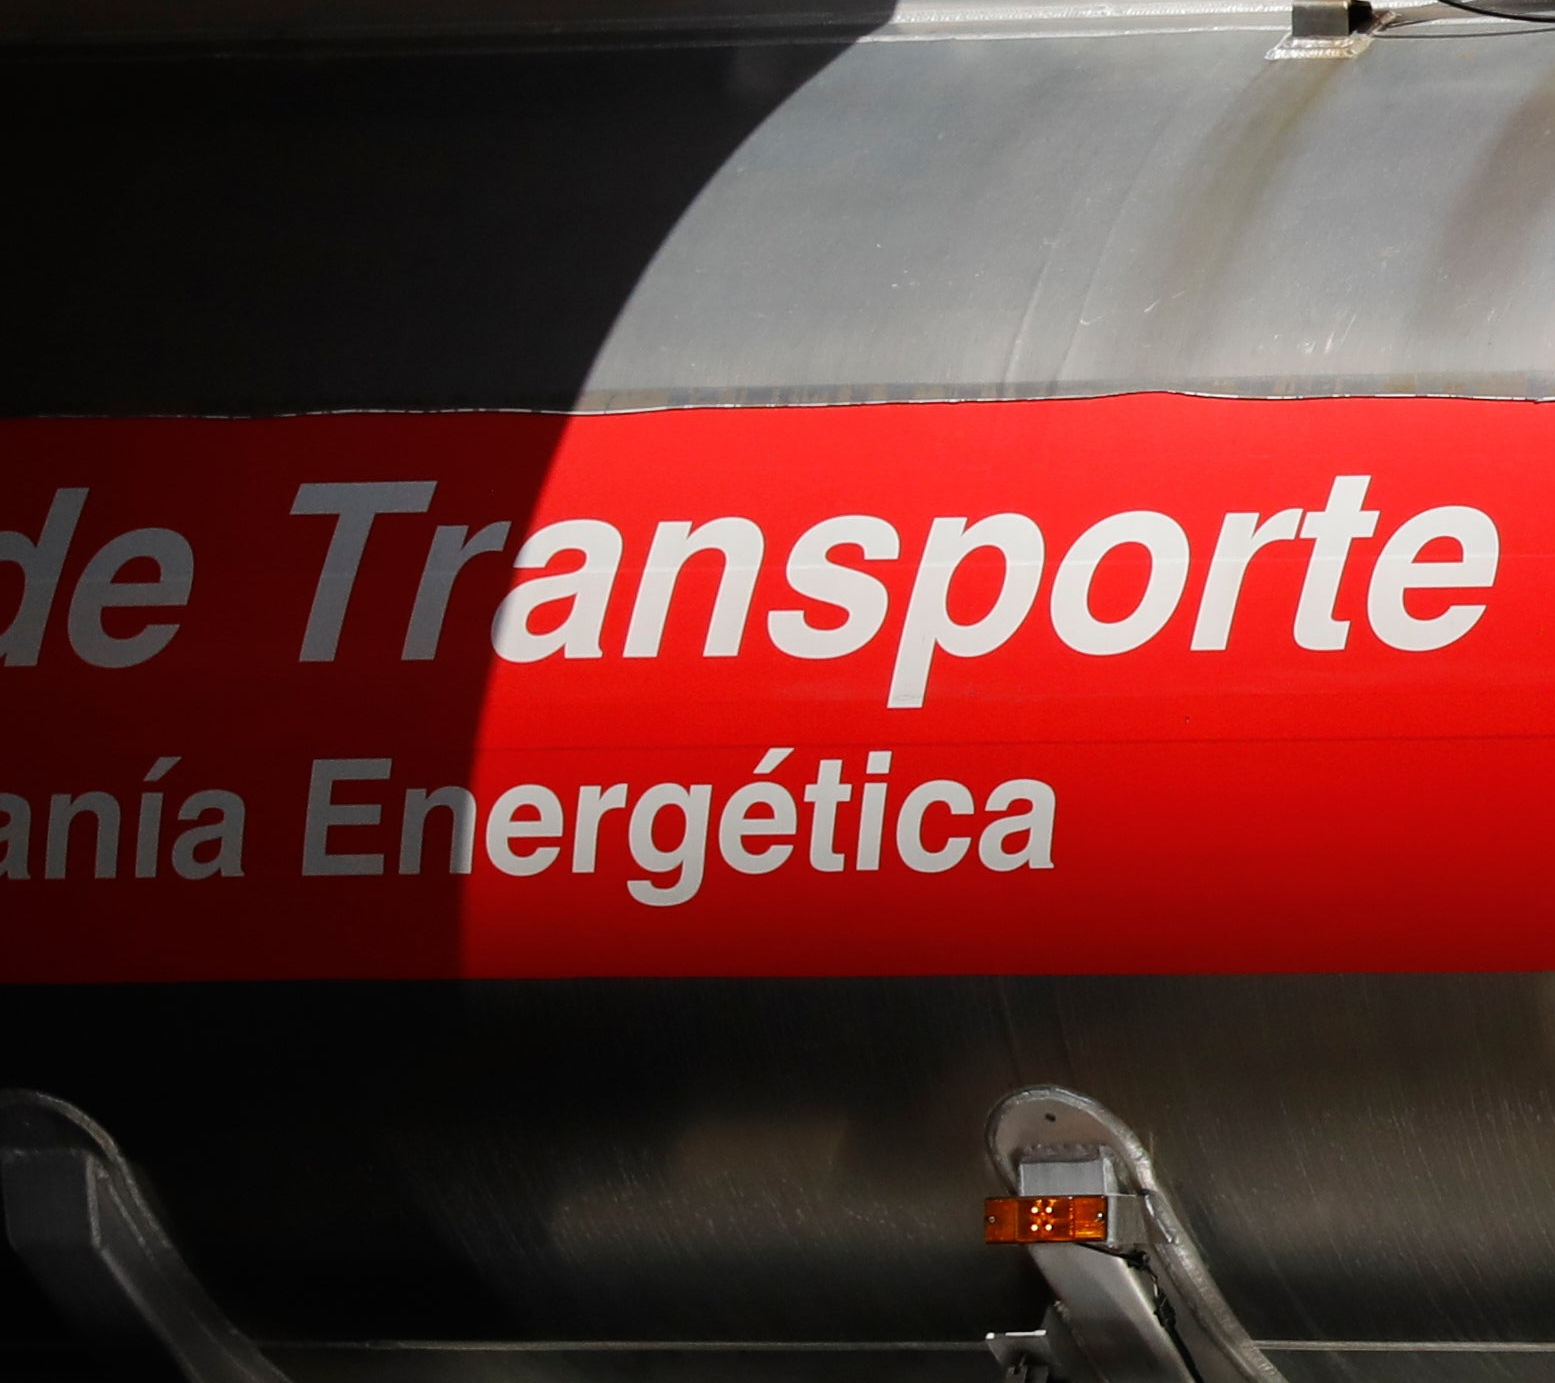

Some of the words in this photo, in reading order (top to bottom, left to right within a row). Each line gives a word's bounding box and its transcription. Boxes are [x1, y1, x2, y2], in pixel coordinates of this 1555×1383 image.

[0, 487, 195, 669] de
[287, 474, 1500, 709] Transporte
[301, 747, 1058, 907] Energética
